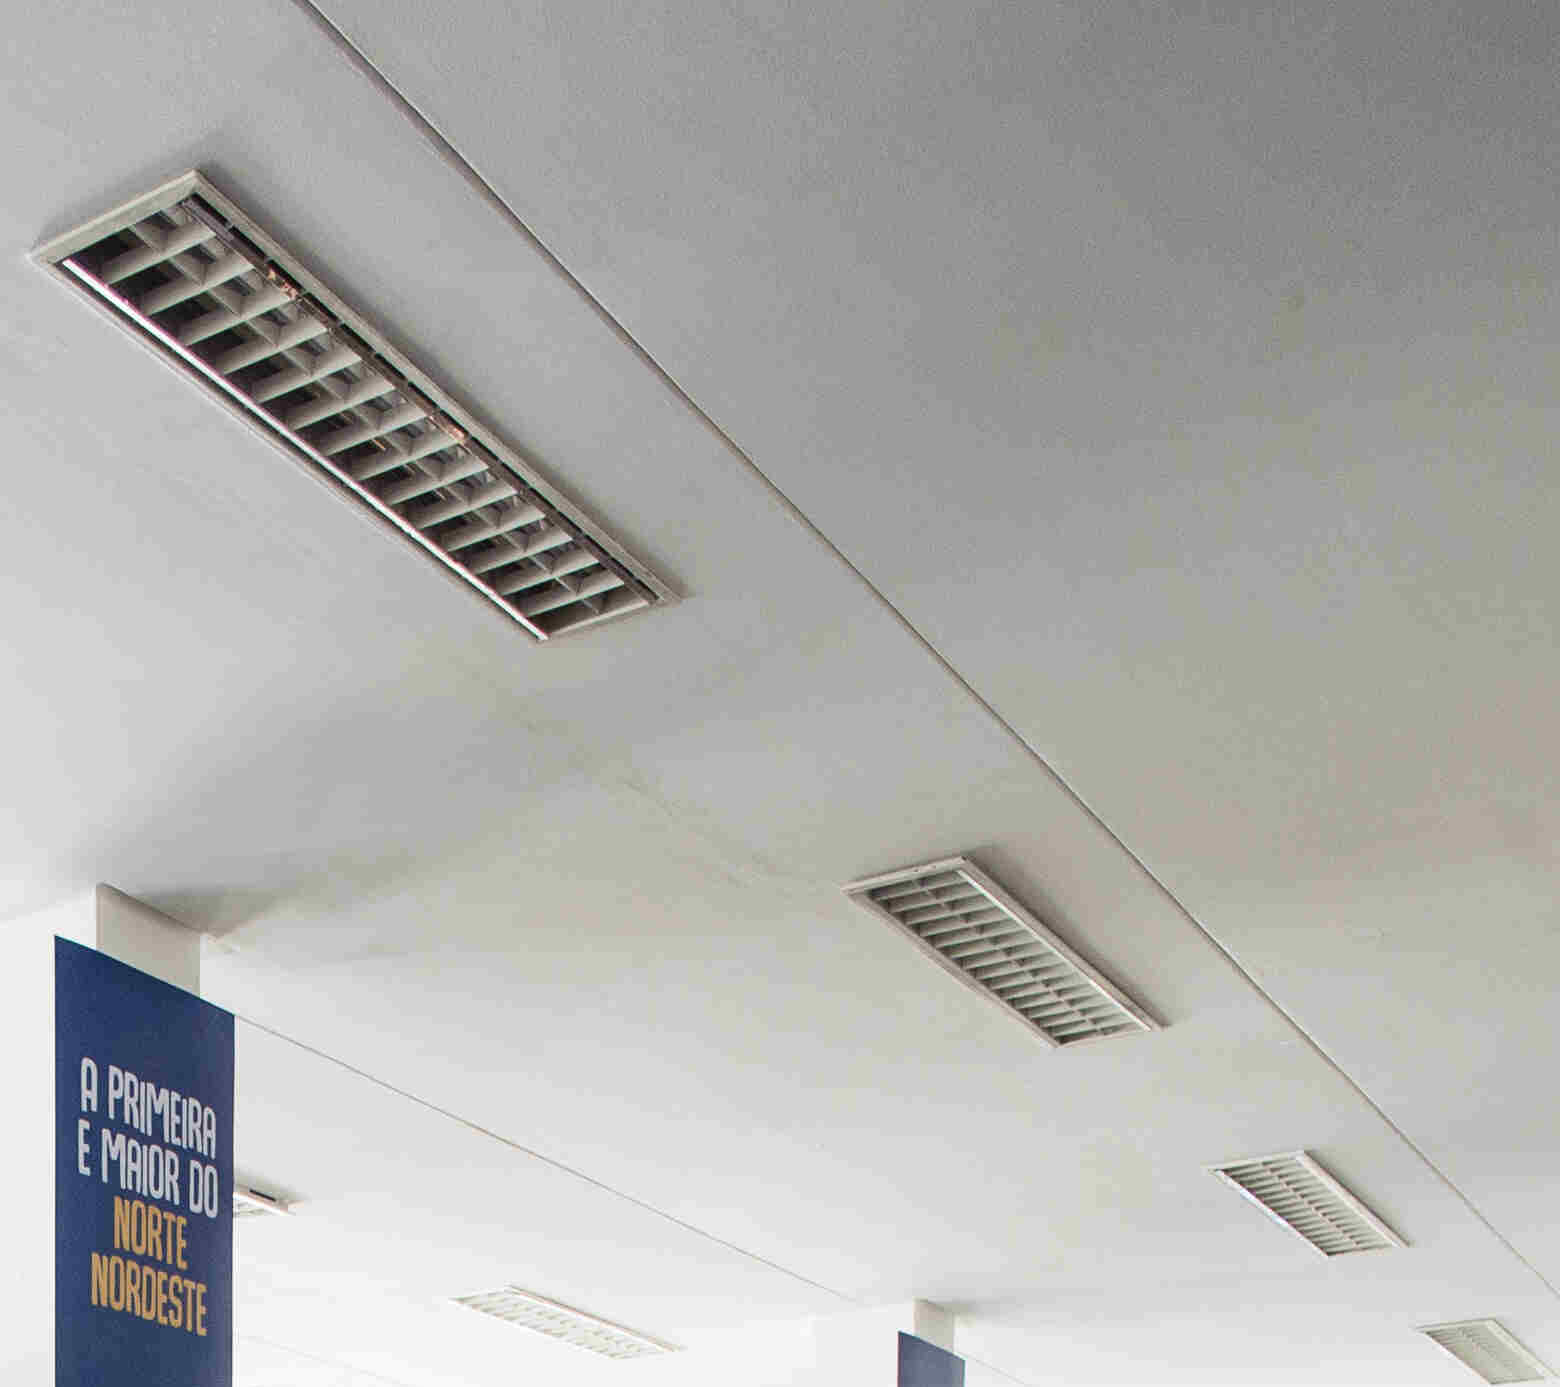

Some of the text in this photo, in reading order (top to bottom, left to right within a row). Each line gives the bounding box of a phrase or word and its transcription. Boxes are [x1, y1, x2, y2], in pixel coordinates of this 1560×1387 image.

[80, 1057, 217, 1160] A PRIMEIRA
[78, 1119, 218, 1219] E MAIOR DO
[114, 1195, 188, 1270] NORTE
[91, 1253, 207, 1337] NORDESTE
